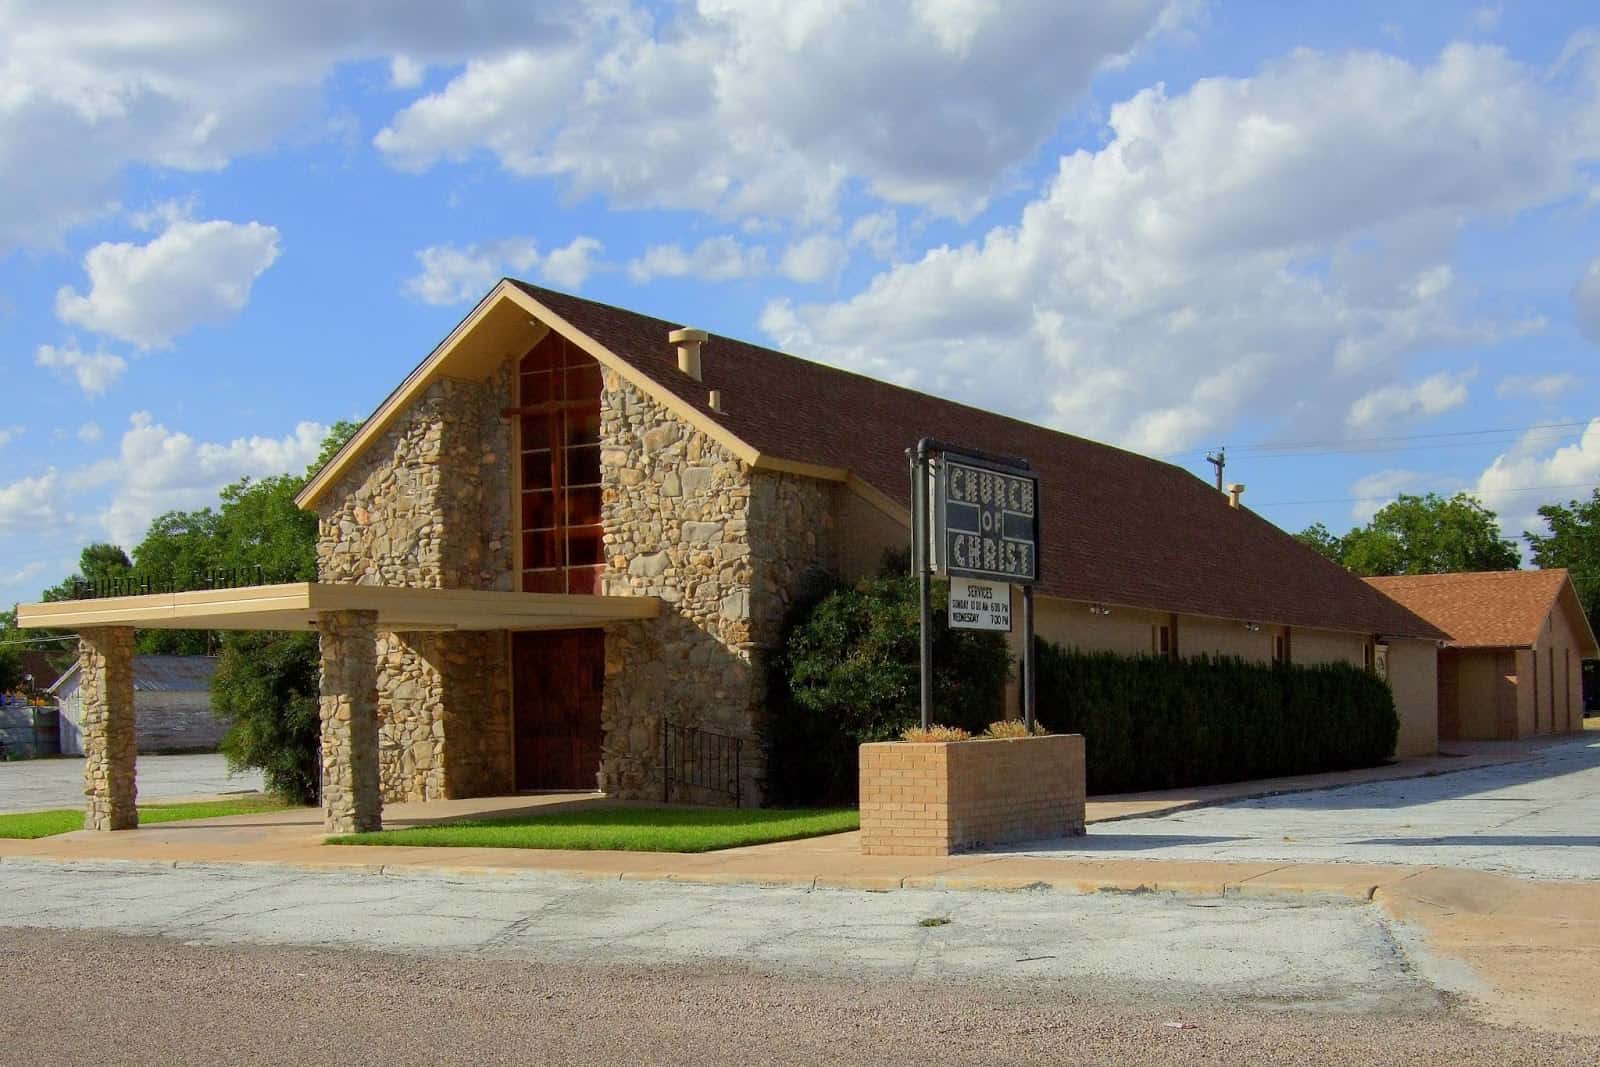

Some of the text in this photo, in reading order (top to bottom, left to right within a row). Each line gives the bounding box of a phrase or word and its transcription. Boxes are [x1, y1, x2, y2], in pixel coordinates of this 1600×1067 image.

[951, 468, 1034, 514] CHURCH
[982, 510, 1001, 533] OF
[953, 534, 1030, 576] CHRIST
[967, 584, 993, 600] SERVICES
[952, 612, 980, 624] WEDNESDAY
